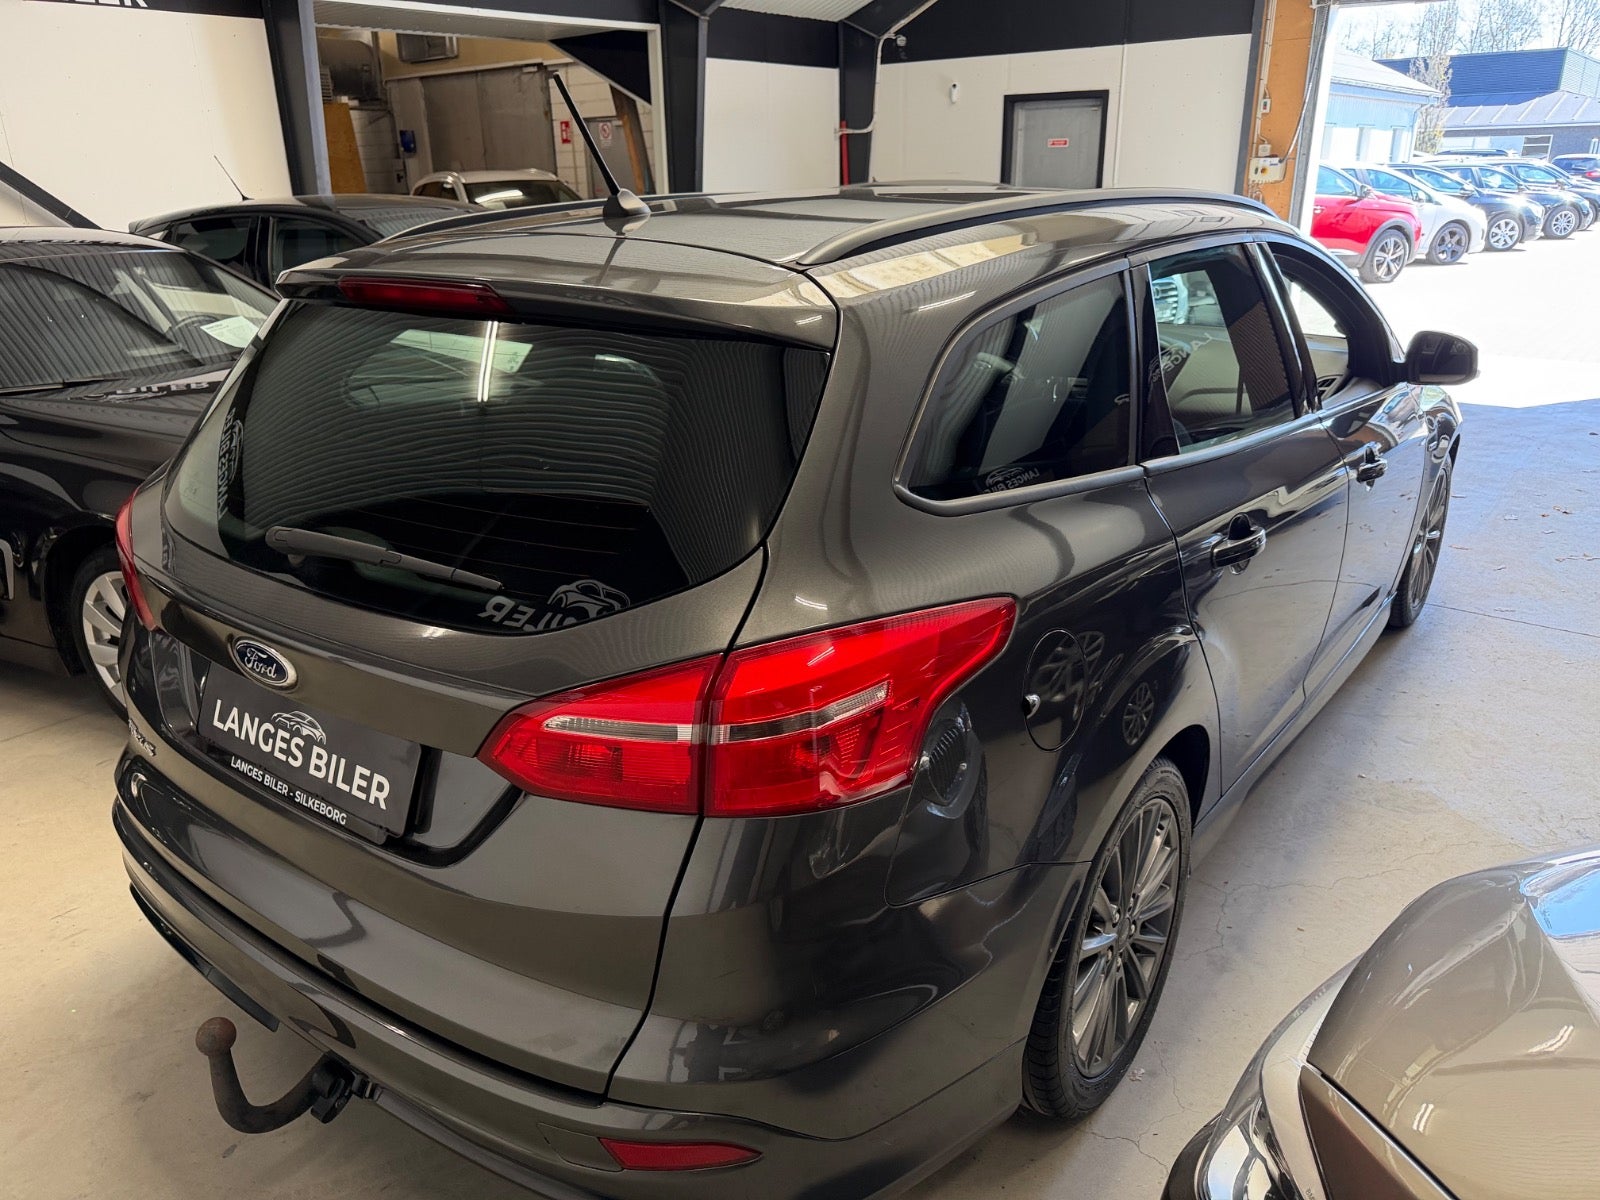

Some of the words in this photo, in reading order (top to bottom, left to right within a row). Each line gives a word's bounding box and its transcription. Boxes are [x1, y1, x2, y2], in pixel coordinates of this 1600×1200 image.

[245, 648, 277, 679] Ford
[212, 699, 305, 767] LANGES
[308, 745, 389, 810] BILER
[230, 755, 263, 782] LANGES
[264, 775, 288, 797] BILER
[294, 790, 347, 825] SILKEBORG
